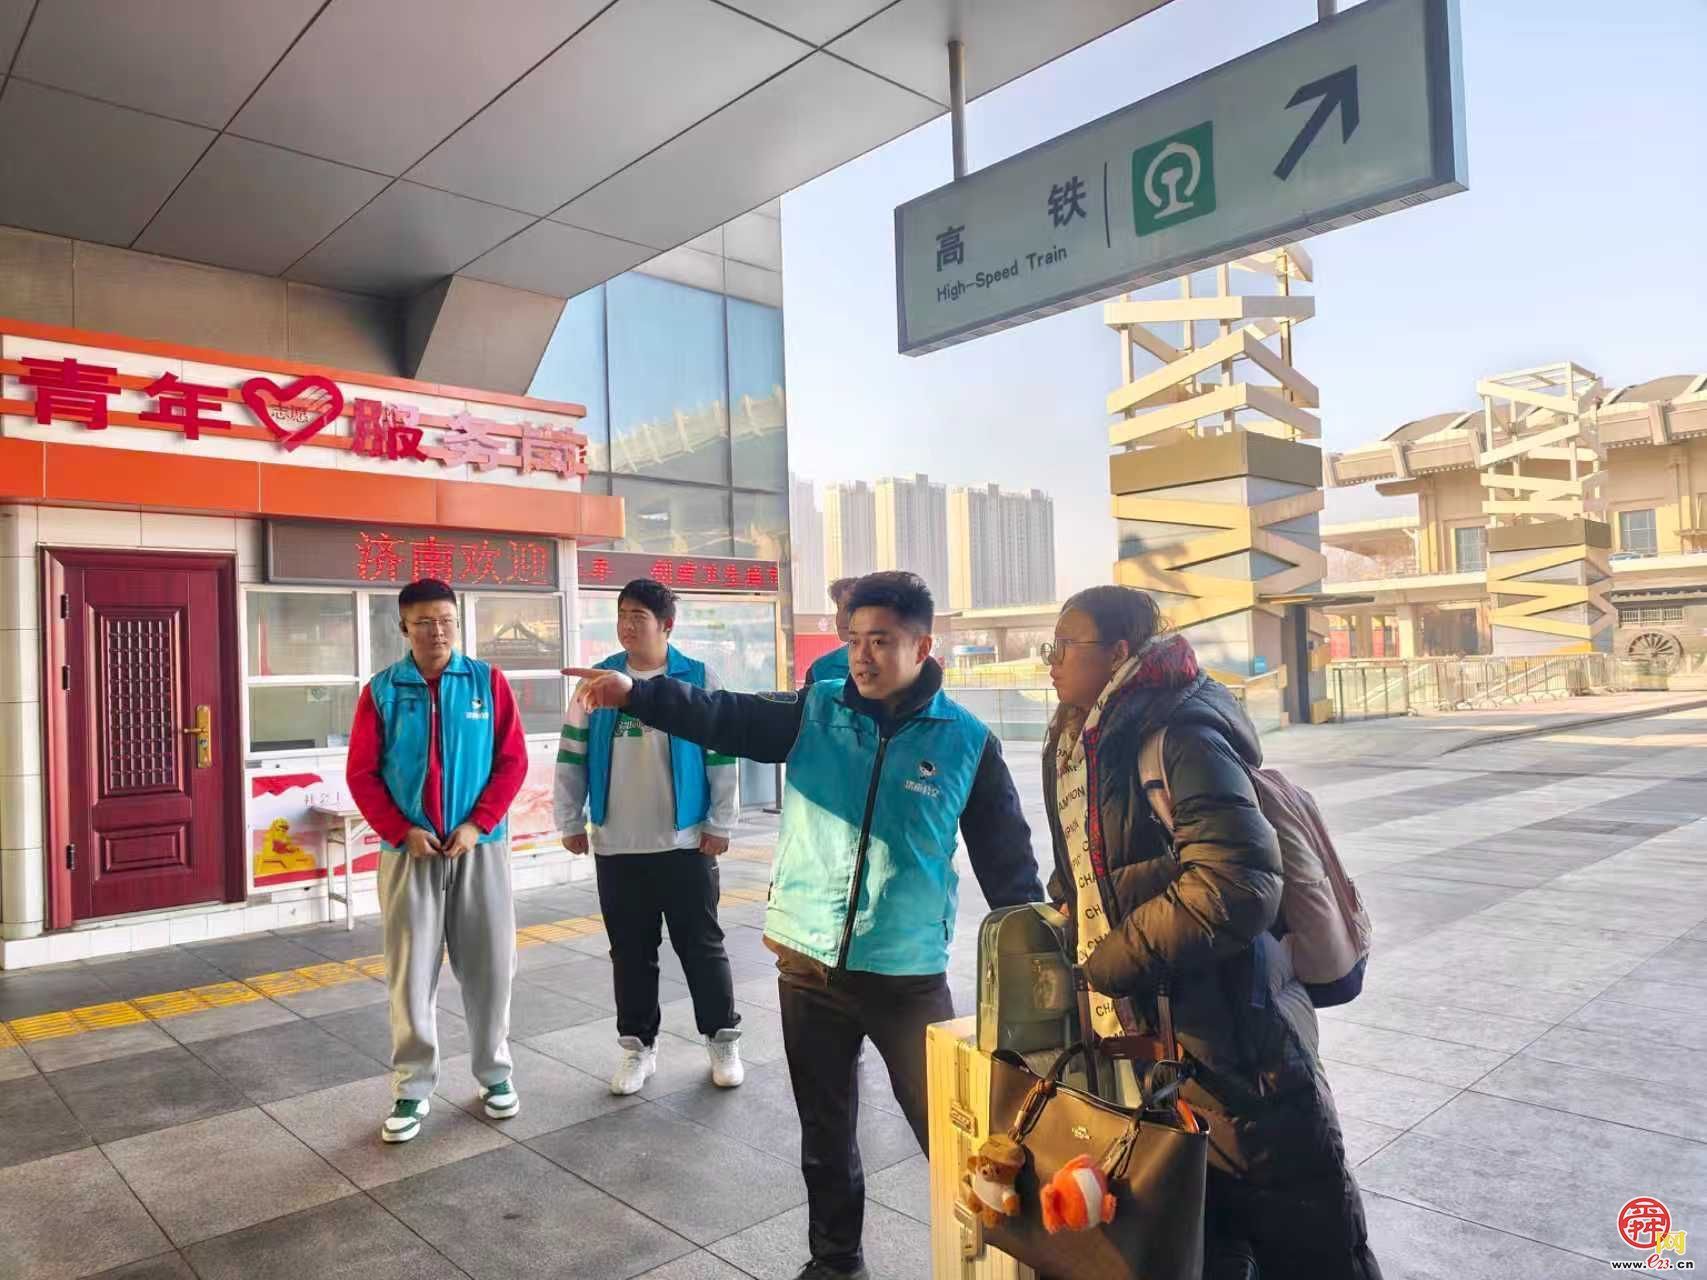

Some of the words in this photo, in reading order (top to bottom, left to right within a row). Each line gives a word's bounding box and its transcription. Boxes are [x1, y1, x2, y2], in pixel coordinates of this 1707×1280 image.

[936, 176, 1087, 272] 高铁
[936, 260, 1018, 302] High-Speed
[1026, 245, 1068, 270] Train
[19, 357, 231, 440] 青年
[351, 397, 586, 480] 服务岗
[355, 531, 549, 585] 济南欢迎
